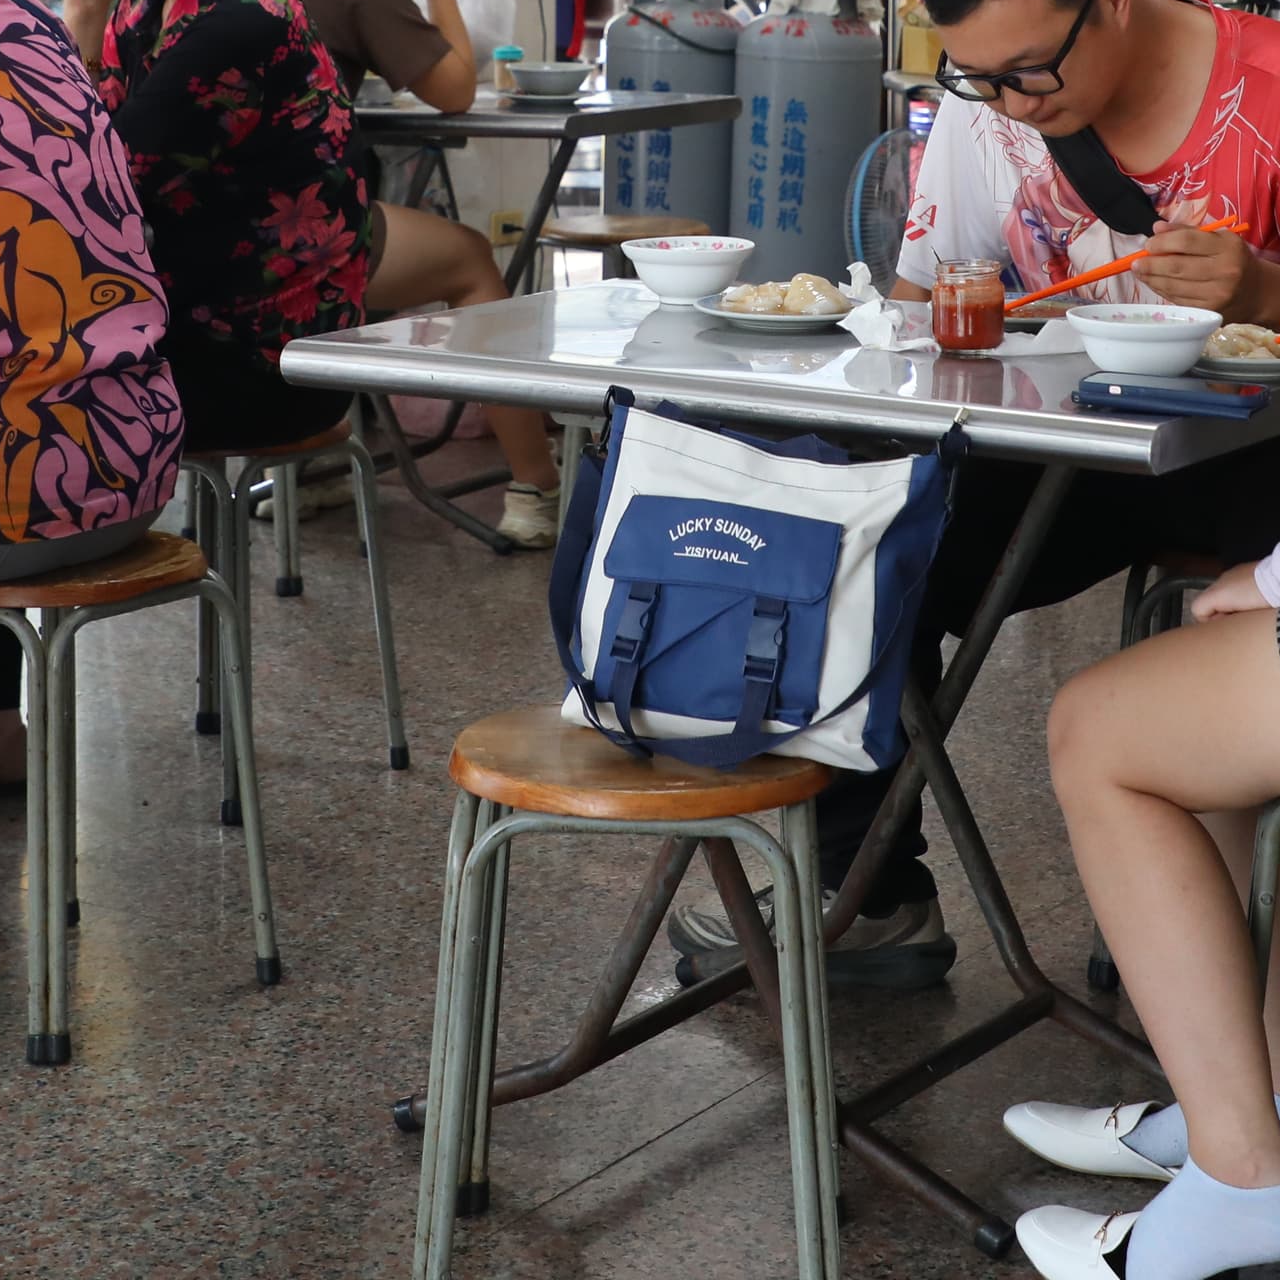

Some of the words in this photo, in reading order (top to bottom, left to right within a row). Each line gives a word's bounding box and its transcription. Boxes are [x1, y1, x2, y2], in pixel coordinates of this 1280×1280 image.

[669, 517, 713, 542] LUCKY
[714, 518, 766, 552] SUNDAY
[684, 545, 739, 563] YISIYUAN
